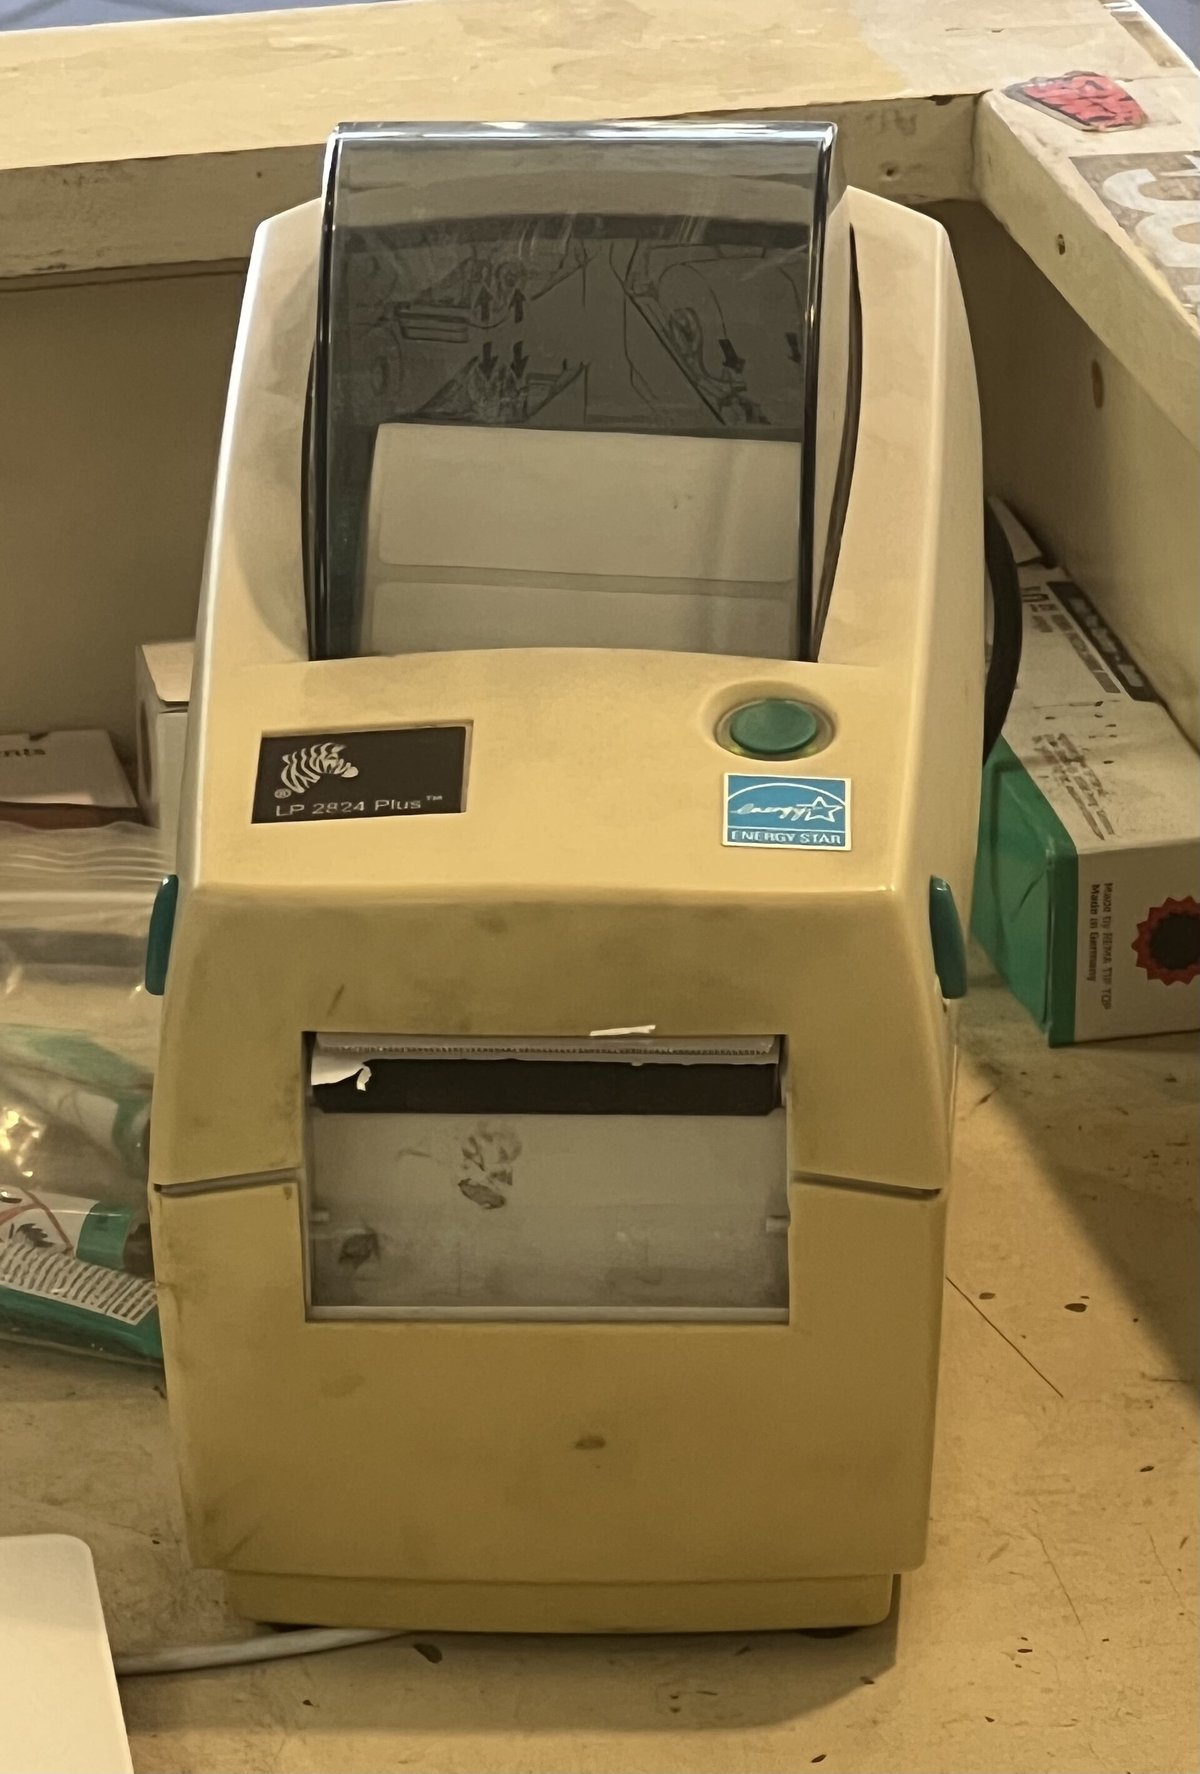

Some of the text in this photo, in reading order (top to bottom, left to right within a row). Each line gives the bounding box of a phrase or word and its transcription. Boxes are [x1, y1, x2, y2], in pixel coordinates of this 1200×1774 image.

[275, 804, 305, 817] LP
[312, 801, 365, 815] 2824
[731, 830, 841, 844] ENERGY STAR
[1089, 883, 1100, 915] Made
[1102, 882, 1114, 913] Made
[1087, 931, 1100, 982] Germany
